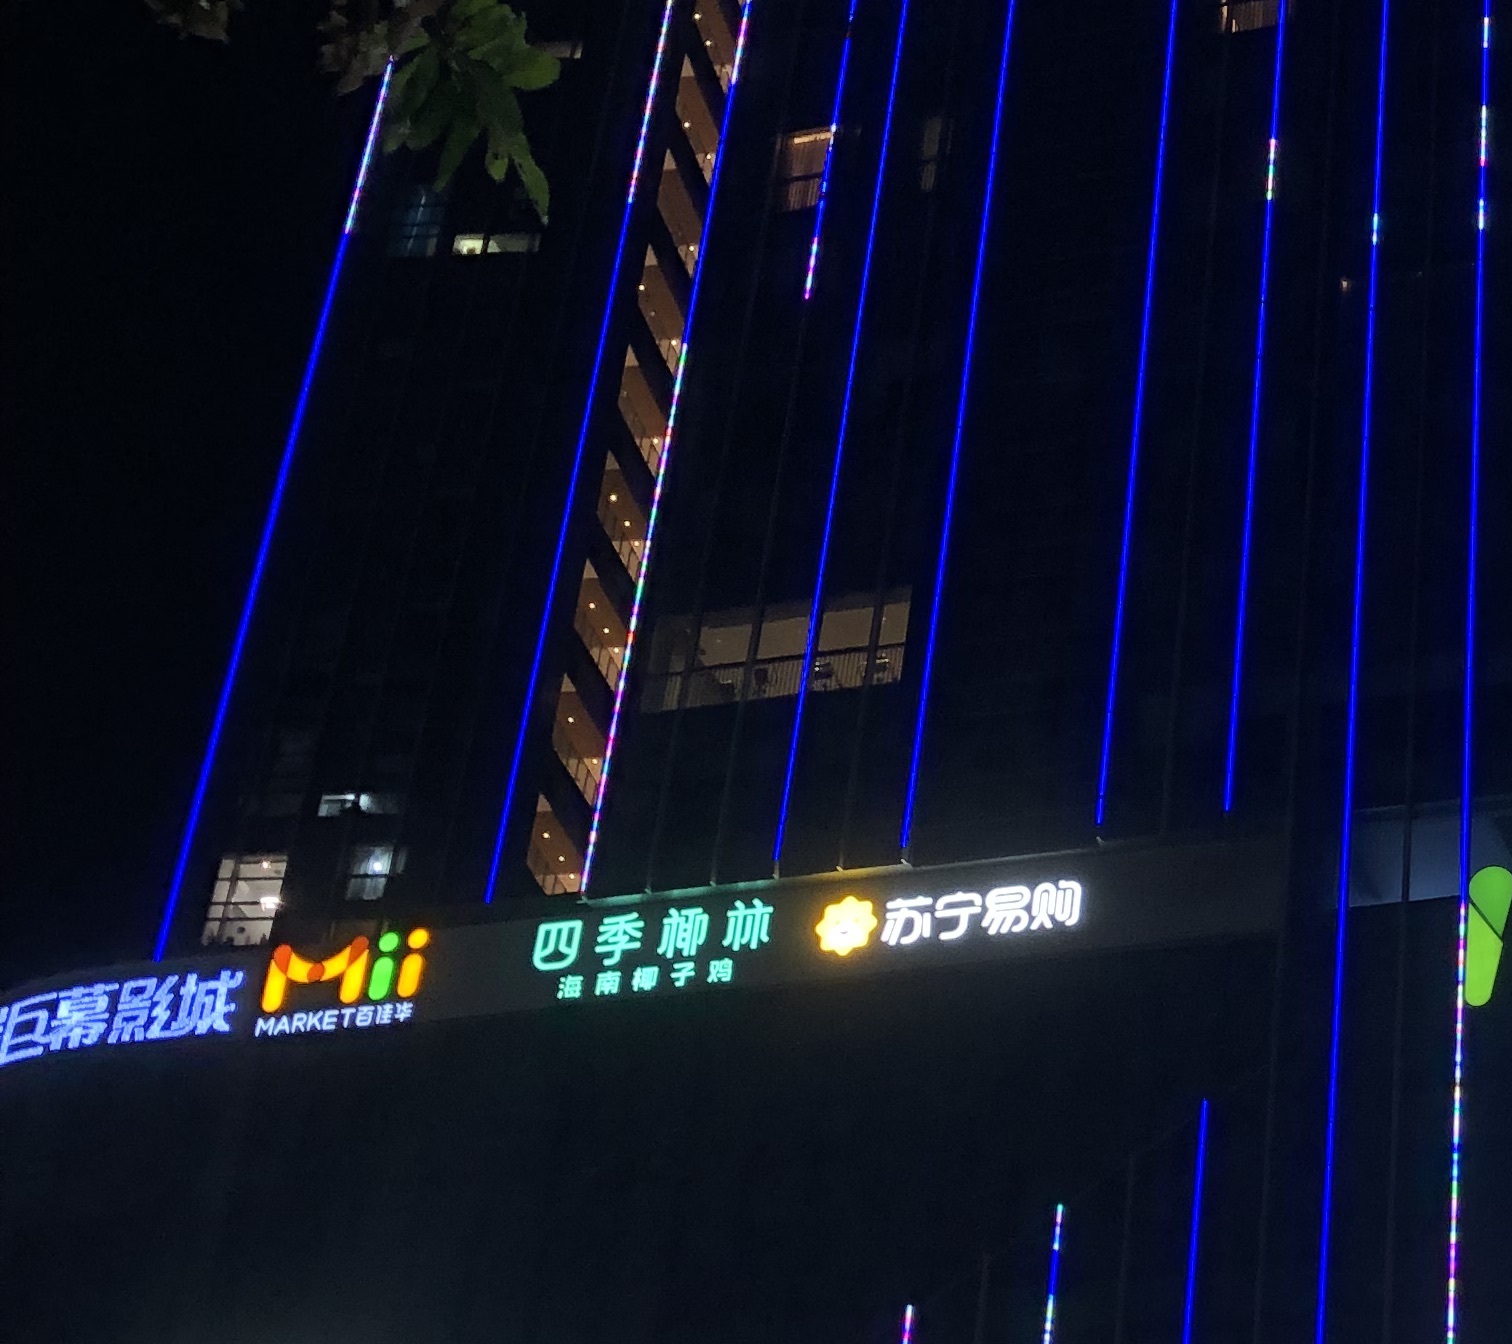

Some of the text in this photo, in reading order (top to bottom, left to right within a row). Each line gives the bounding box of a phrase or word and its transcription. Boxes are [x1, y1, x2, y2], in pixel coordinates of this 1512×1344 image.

[532, 897, 774, 971] 四季椰林
[881, 879, 1082, 946] 苏宁易购
[557, 958, 734, 999] 海南椰子鸡
[0, 969, 245, 1066] 巨幕影城
